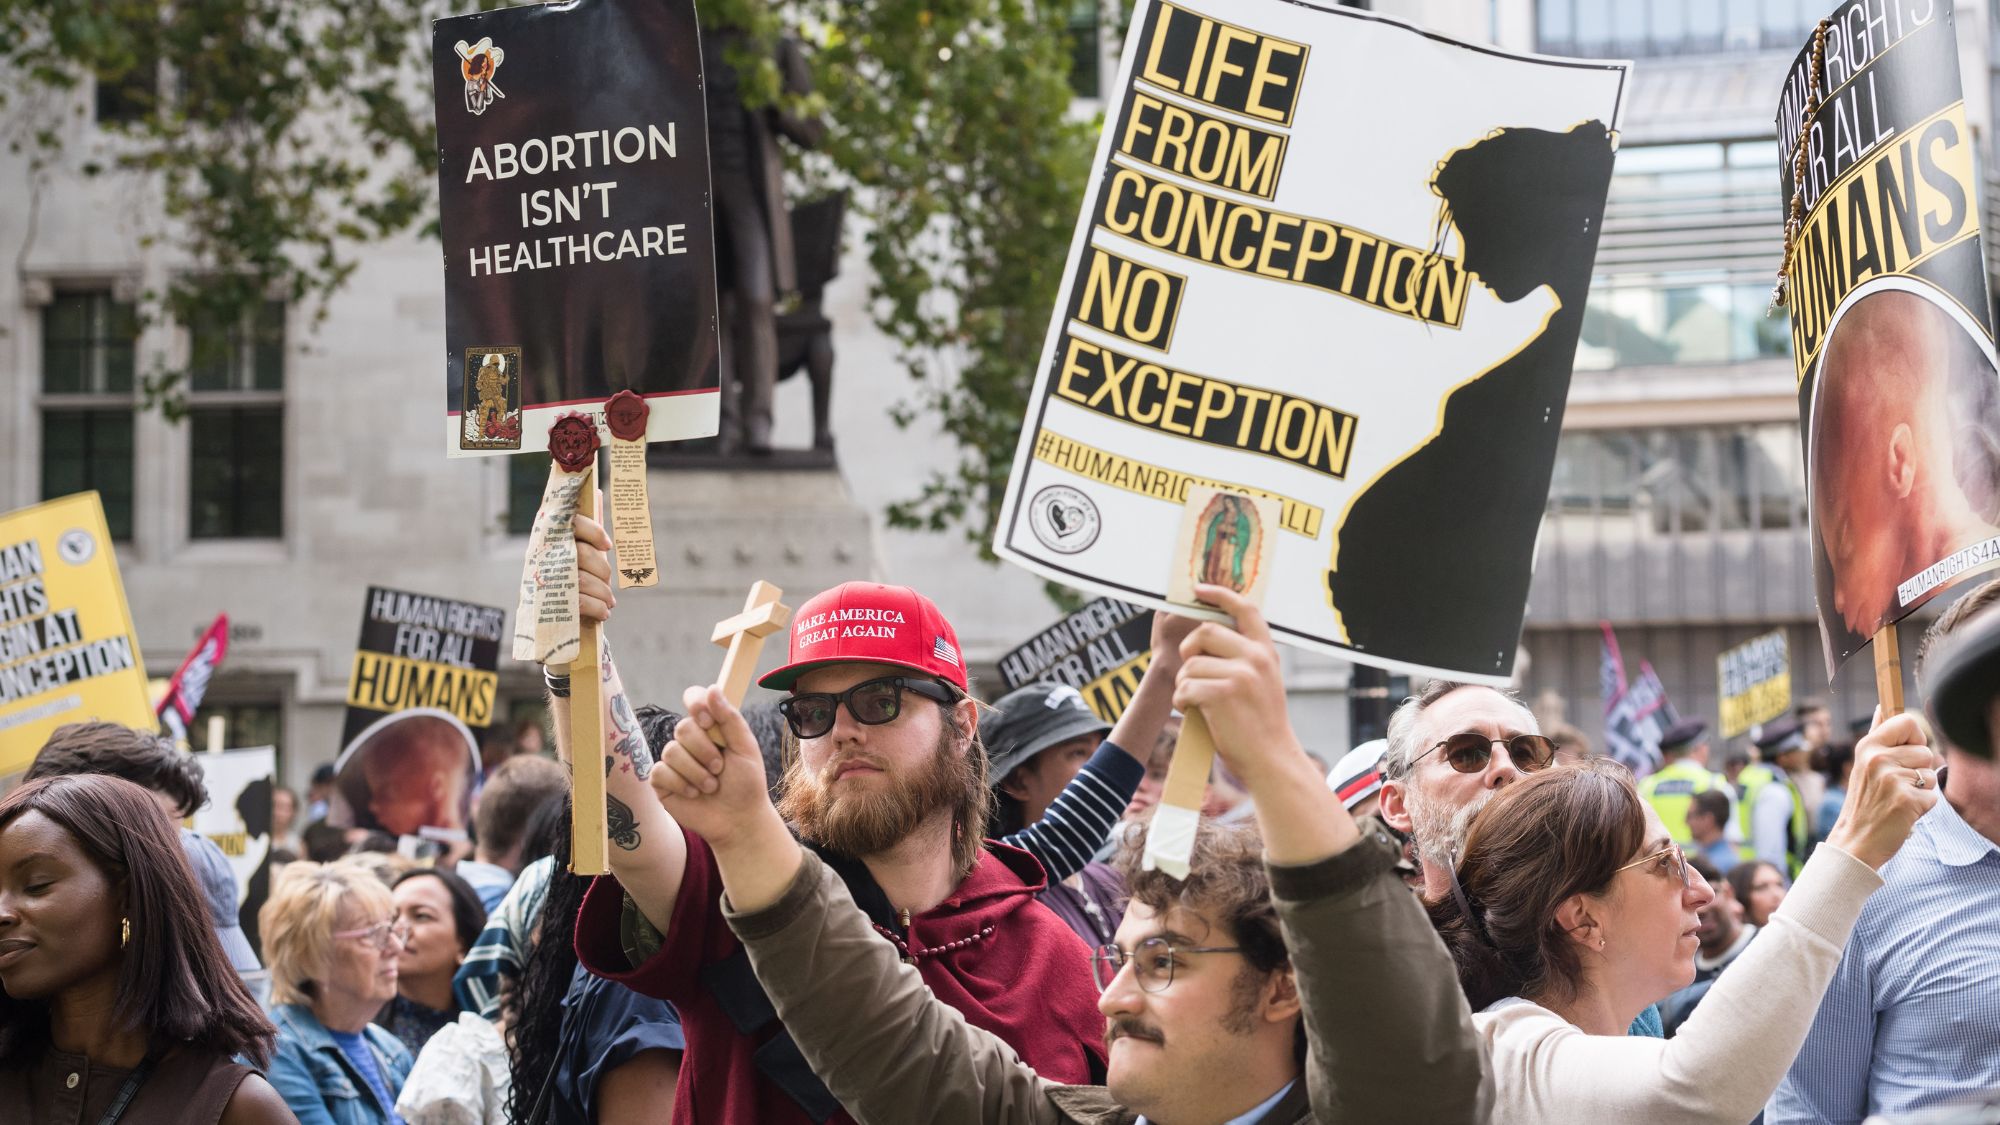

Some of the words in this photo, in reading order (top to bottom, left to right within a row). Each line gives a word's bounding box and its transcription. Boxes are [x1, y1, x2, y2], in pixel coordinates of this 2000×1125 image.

[1143, 3, 1301, 121] LIFE
[465, 122, 677, 183] ABORTION
[1122, 93, 1281, 196] FROM
[1835, 71, 1894, 177] ALL
[469, 223, 687, 277] HEALTHCARE
[1104, 169, 1467, 324] CONCEPTION
[1790, 119, 1967, 356] HUMANS
[1079, 251, 1171, 343] NO
[1057, 338, 1353, 474] EXCEPTION
[371, 590, 443, 630] HUMAN
[448, 602, 502, 641] RIGHTS
[394, 624, 440, 663] FOR
[441, 633, 476, 670] ALL
[797, 612, 826, 635] MAKE
[828, 608, 905, 624] AMERICA
[799, 627, 838, 649] GREAT
[841, 625, 896, 638] AGAIN
[1001, 622, 1078, 688] HUMAN
[1087, 629, 1140, 678] ALL
[354, 656, 492, 721] HUMANS
